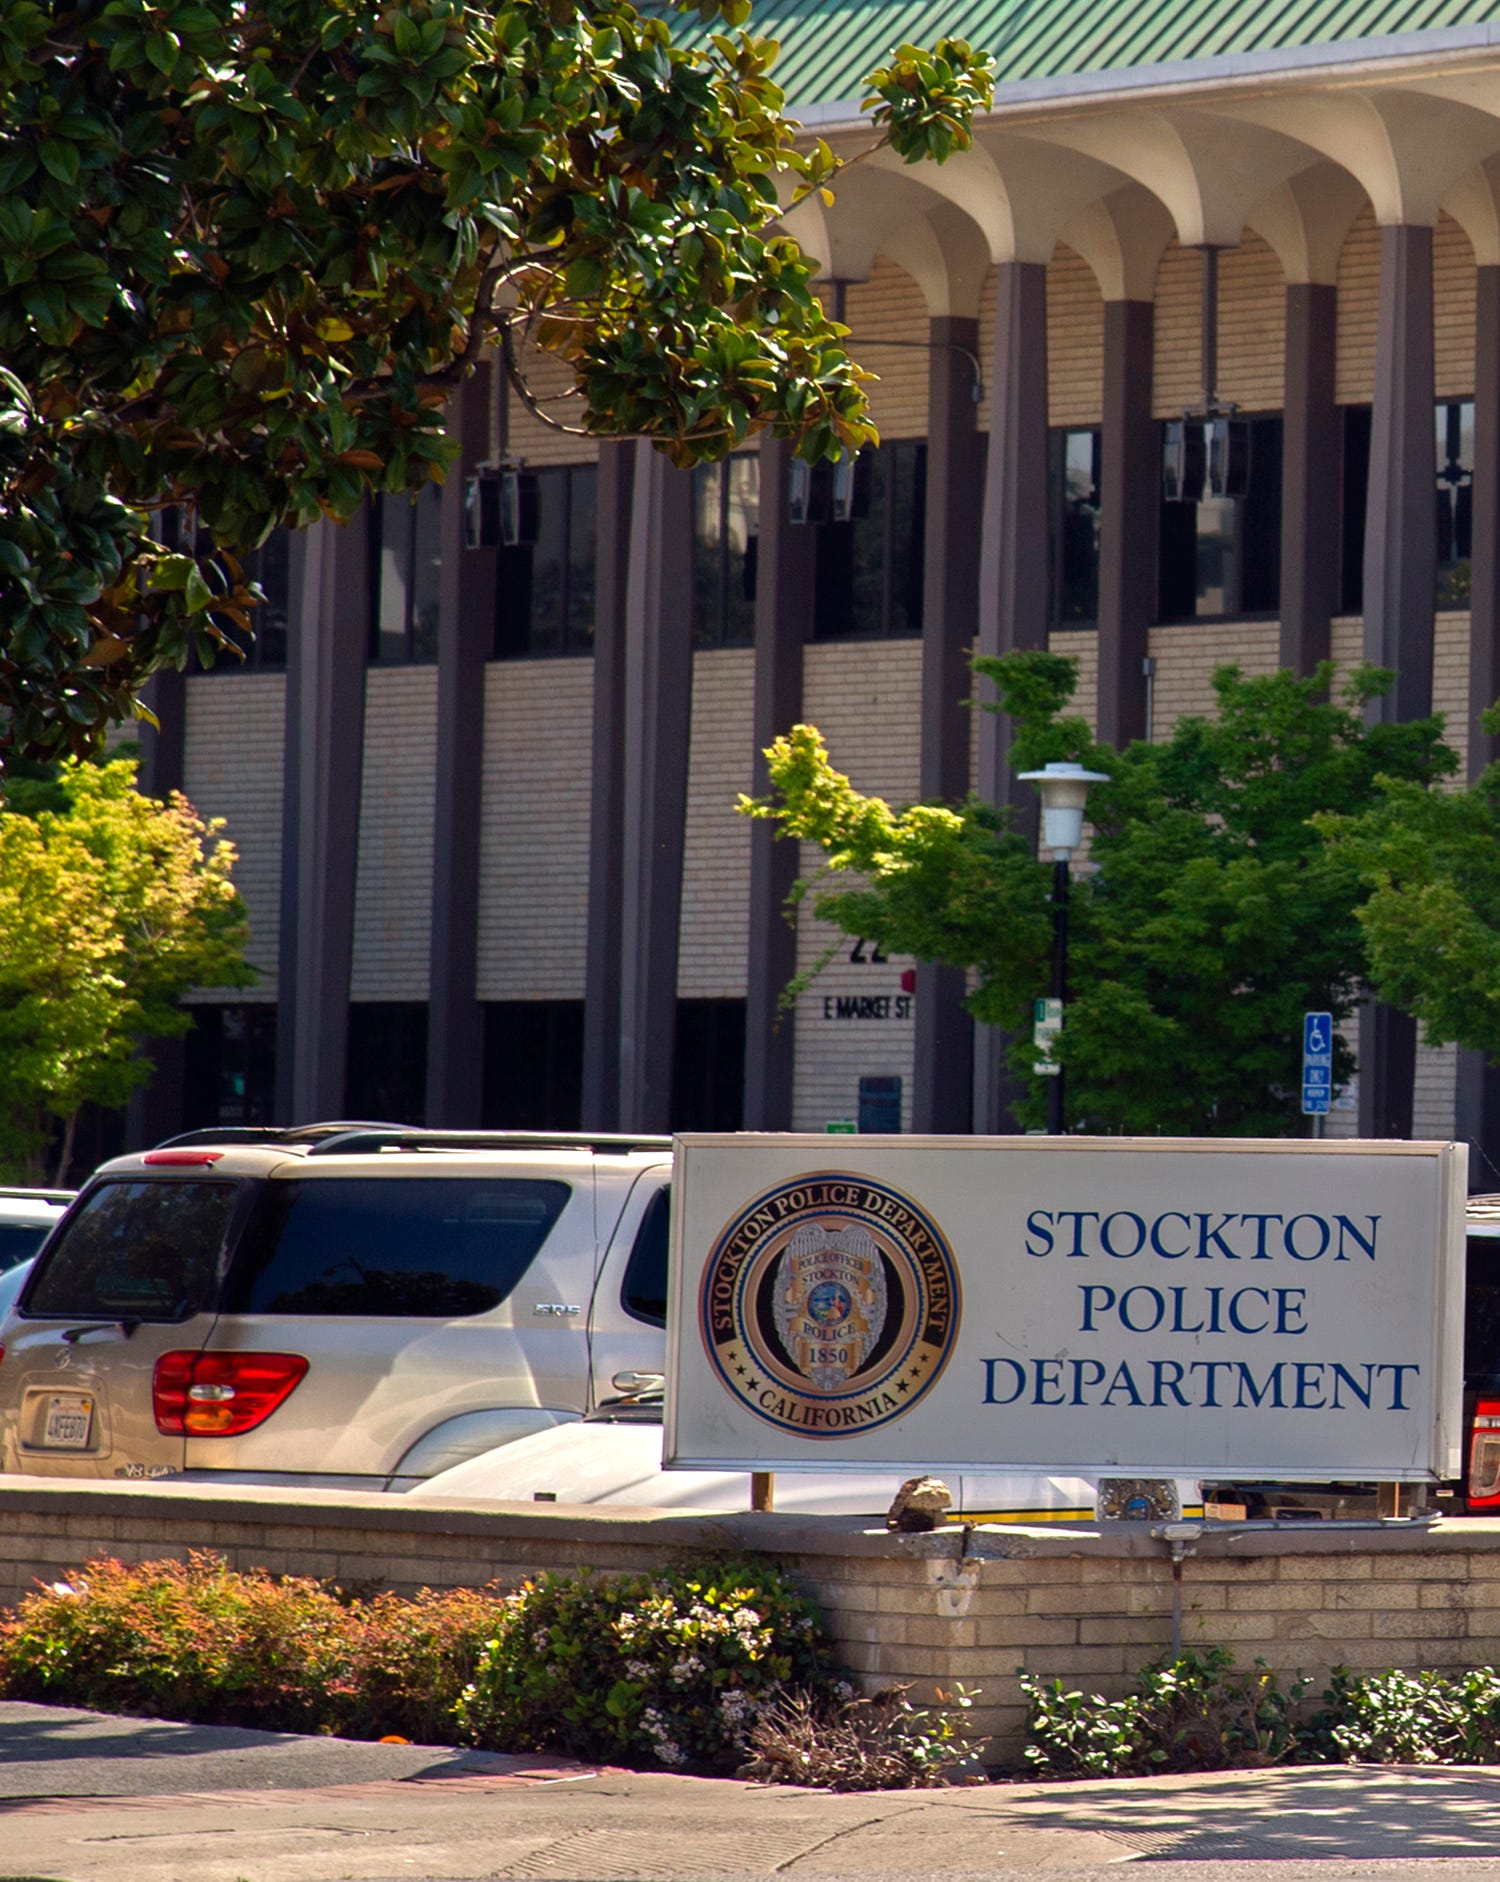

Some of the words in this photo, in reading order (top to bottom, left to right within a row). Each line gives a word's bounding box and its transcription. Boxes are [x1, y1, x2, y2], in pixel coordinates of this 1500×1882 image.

[825, 996, 834, 1019] E
[837, 996, 890, 1019] MARKET
[896, 996, 912, 1019] ST
[1025, 1210, 1382, 1261] STOCKTON
[713, 1208, 778, 1330] STOCKTON
[774, 1184, 860, 1216] POLICE
[862, 1190, 949, 1332] DEPARTMENT
[802, 1269, 860, 1287] STOCKTON
[1077, 1285, 1308, 1335] POLICE
[803, 1321, 856, 1341] POLICE
[809, 1348, 848, 1363] 1850
[979, 1358, 1420, 1410] DEPARTMENT
[758, 1389, 898, 1428] CALIFORNIA
